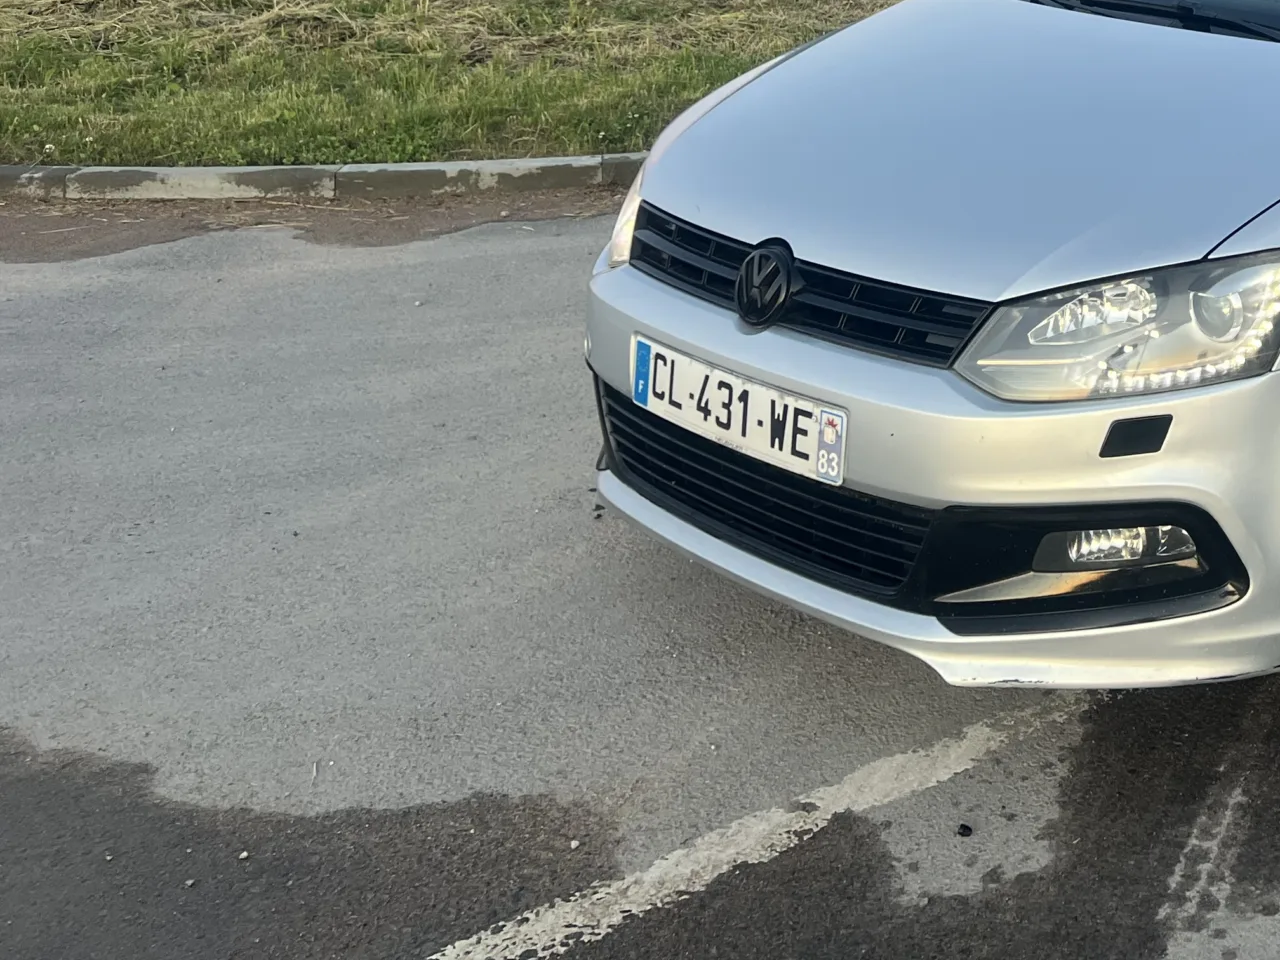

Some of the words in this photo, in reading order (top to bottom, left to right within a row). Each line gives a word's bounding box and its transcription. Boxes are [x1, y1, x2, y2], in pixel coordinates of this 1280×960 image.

[638, 379, 645, 393] F
[652, 352, 814, 461] CL-431-WE
[818, 449, 839, 477] 83
